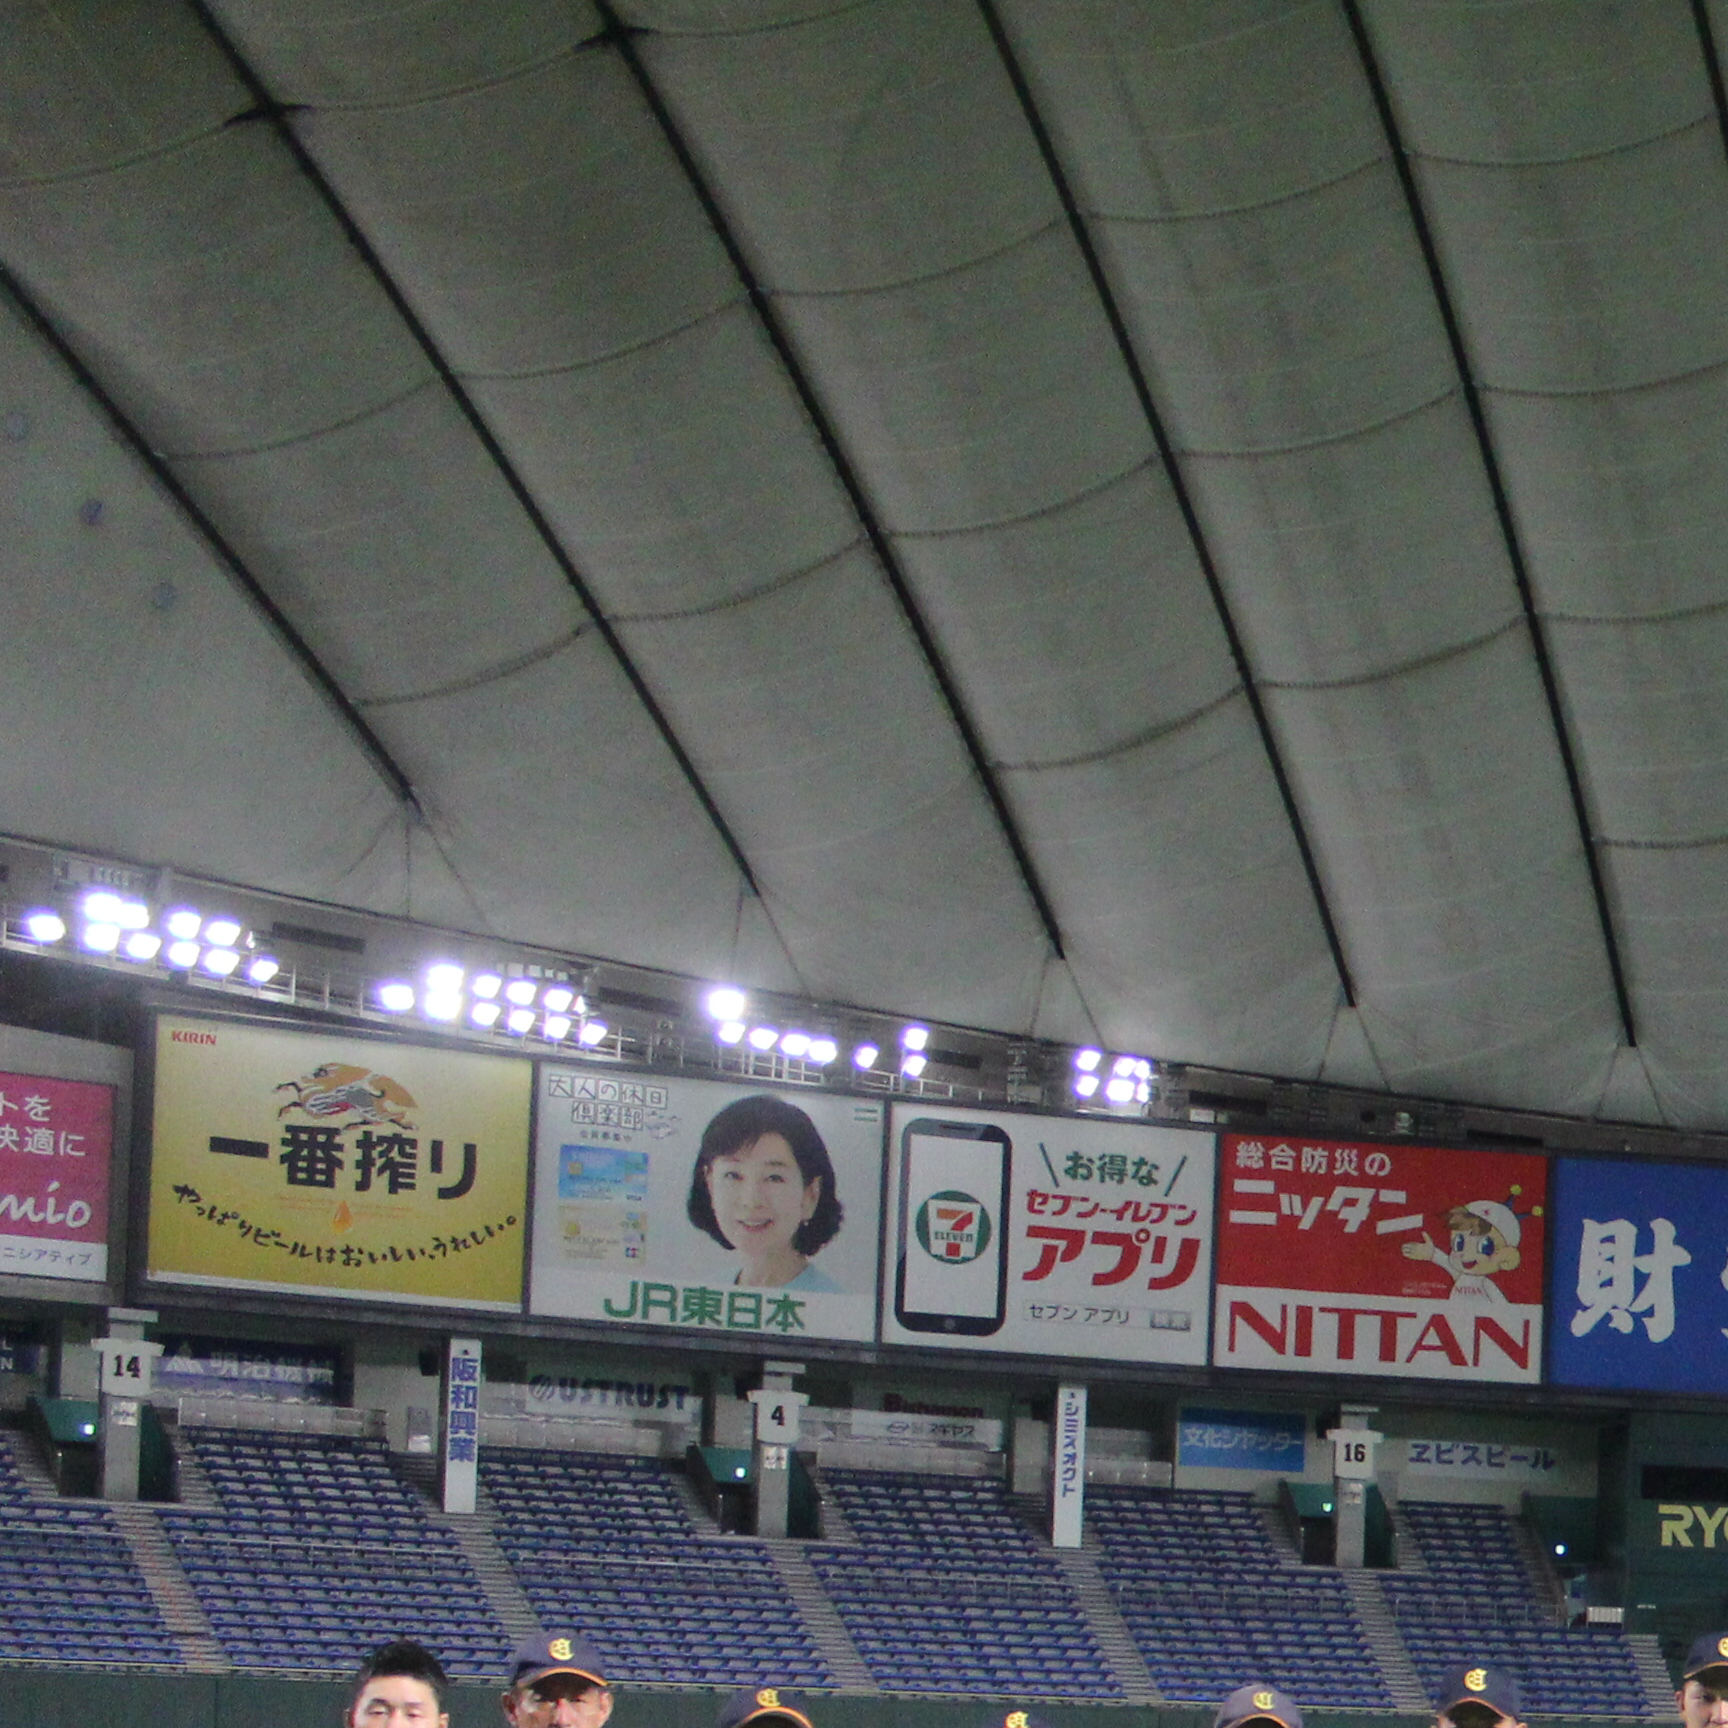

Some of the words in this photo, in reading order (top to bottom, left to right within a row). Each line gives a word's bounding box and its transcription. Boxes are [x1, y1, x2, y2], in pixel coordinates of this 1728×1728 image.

[172, 1030, 217, 1045] KIRIN
[209, 1125, 477, 1200] 一番搾り
[1064, 1150, 1161, 1187] お得な
[1235, 1140, 1391, 1178] 総合防災の
[1228, 1178, 1424, 1236] ニッタン
[1020, 1225, 1200, 1291] アプリ
[604, 1281, 807, 1333] JR東日本
[1228, 1300, 1530, 1370] NITTAN
[112, 1353, 142, 1379] 14
[450, 1356, 480, 1463] 阪和興業
[770, 1404, 786, 1427] 4
[1343, 1442, 1366, 1463] 16
